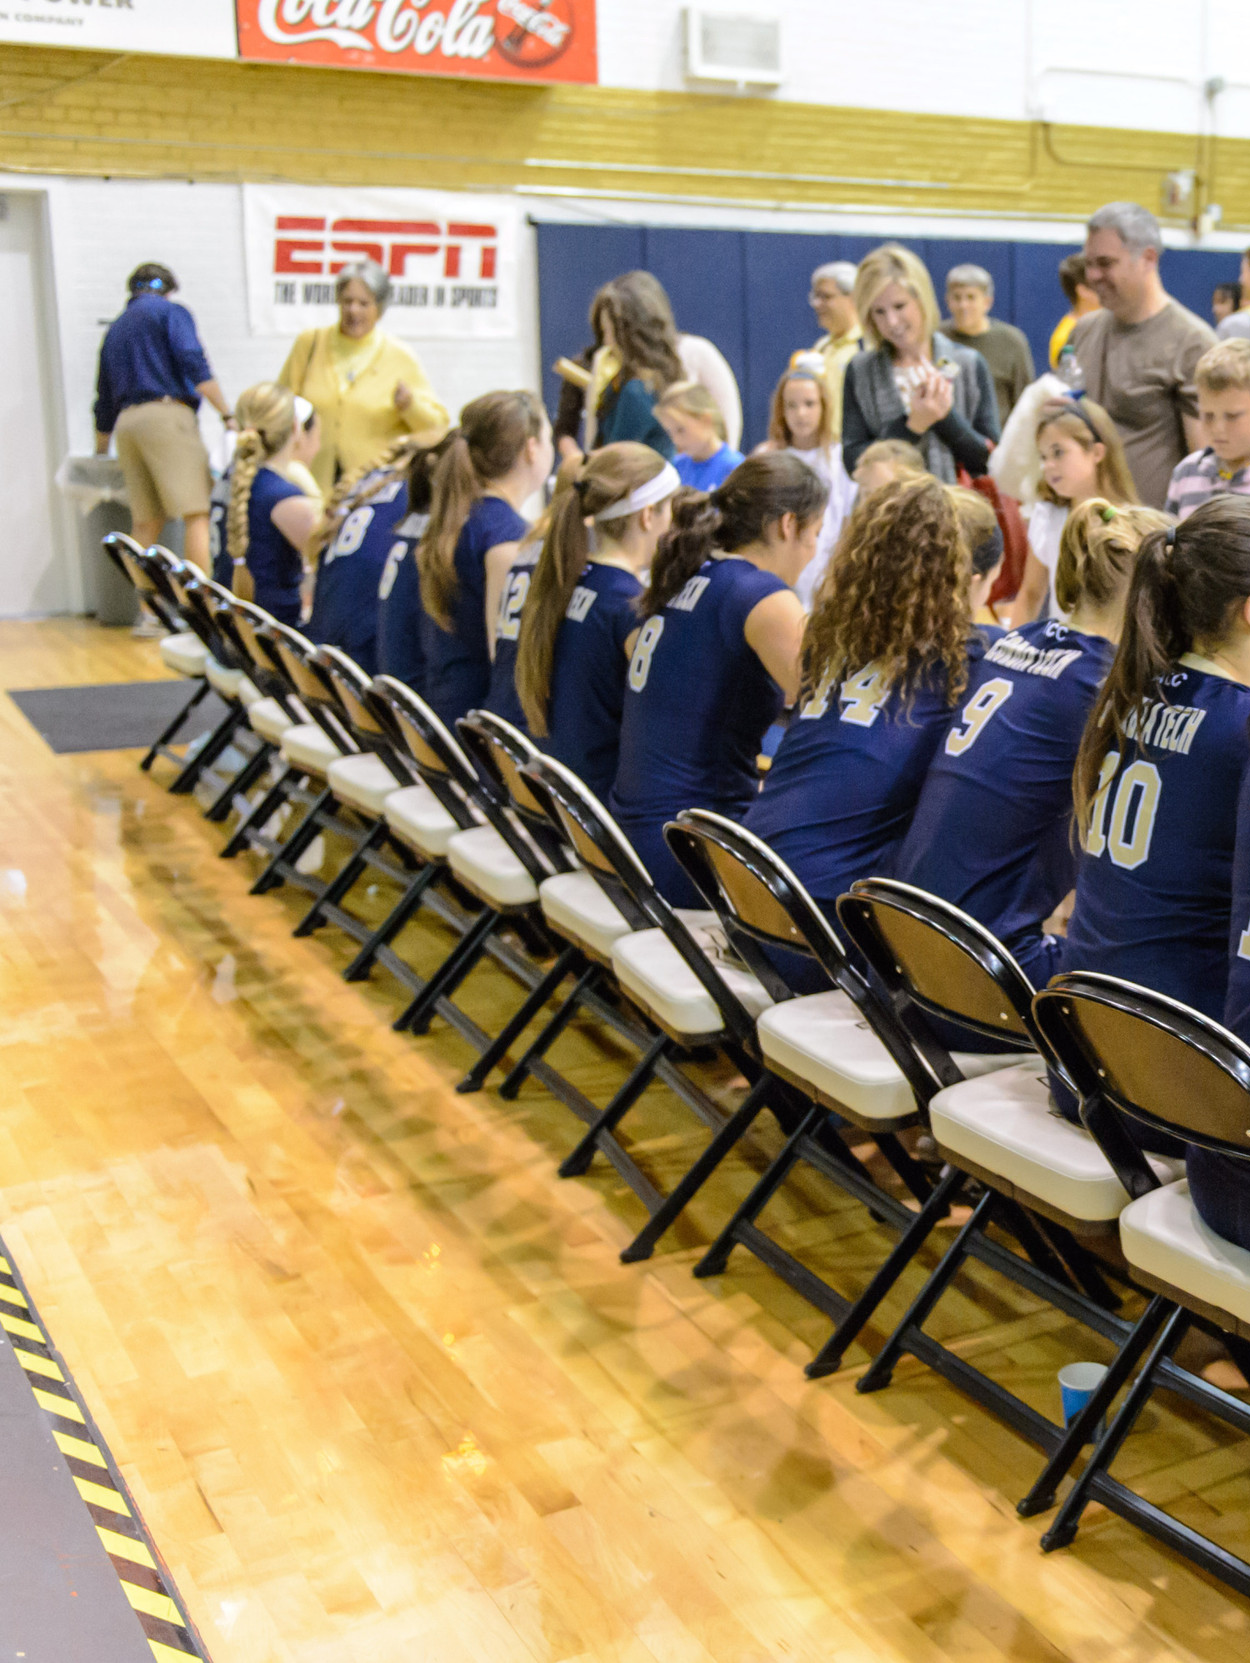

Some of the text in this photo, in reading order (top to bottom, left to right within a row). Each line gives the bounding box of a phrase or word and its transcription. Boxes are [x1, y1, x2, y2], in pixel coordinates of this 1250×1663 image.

[273, 215, 497, 279] ESPN
[628, 614, 665, 693] 8
[800, 660, 891, 727] 14
[945, 677, 1014, 757] 9
[1153, 703, 1208, 755] TECH
[1084, 750, 1162, 871] 10
